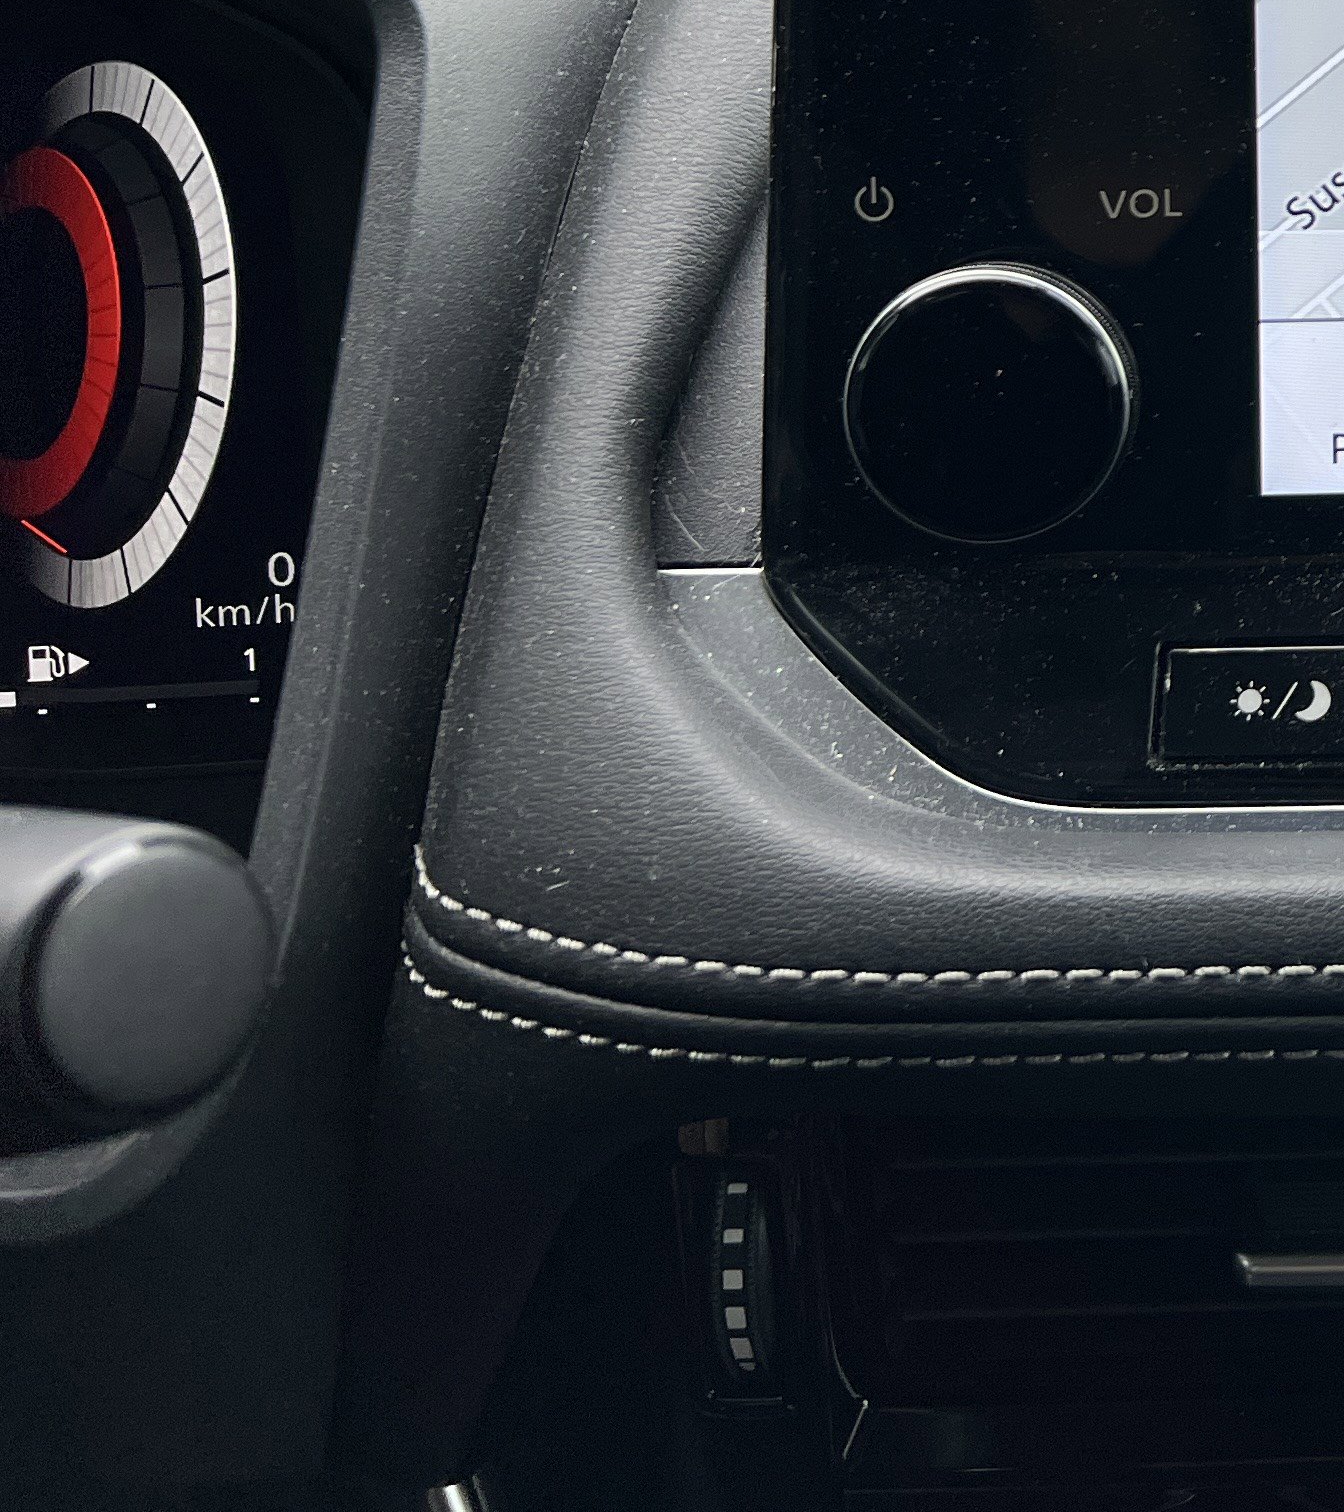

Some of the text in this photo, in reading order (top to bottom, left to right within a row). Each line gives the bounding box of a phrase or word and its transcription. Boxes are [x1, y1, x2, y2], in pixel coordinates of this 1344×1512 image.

[1099, 188, 1184, 220] VOL
[267, 551, 296, 587] 0
[194, 593, 296, 628] km/h
[243, 647, 256, 672] 1
